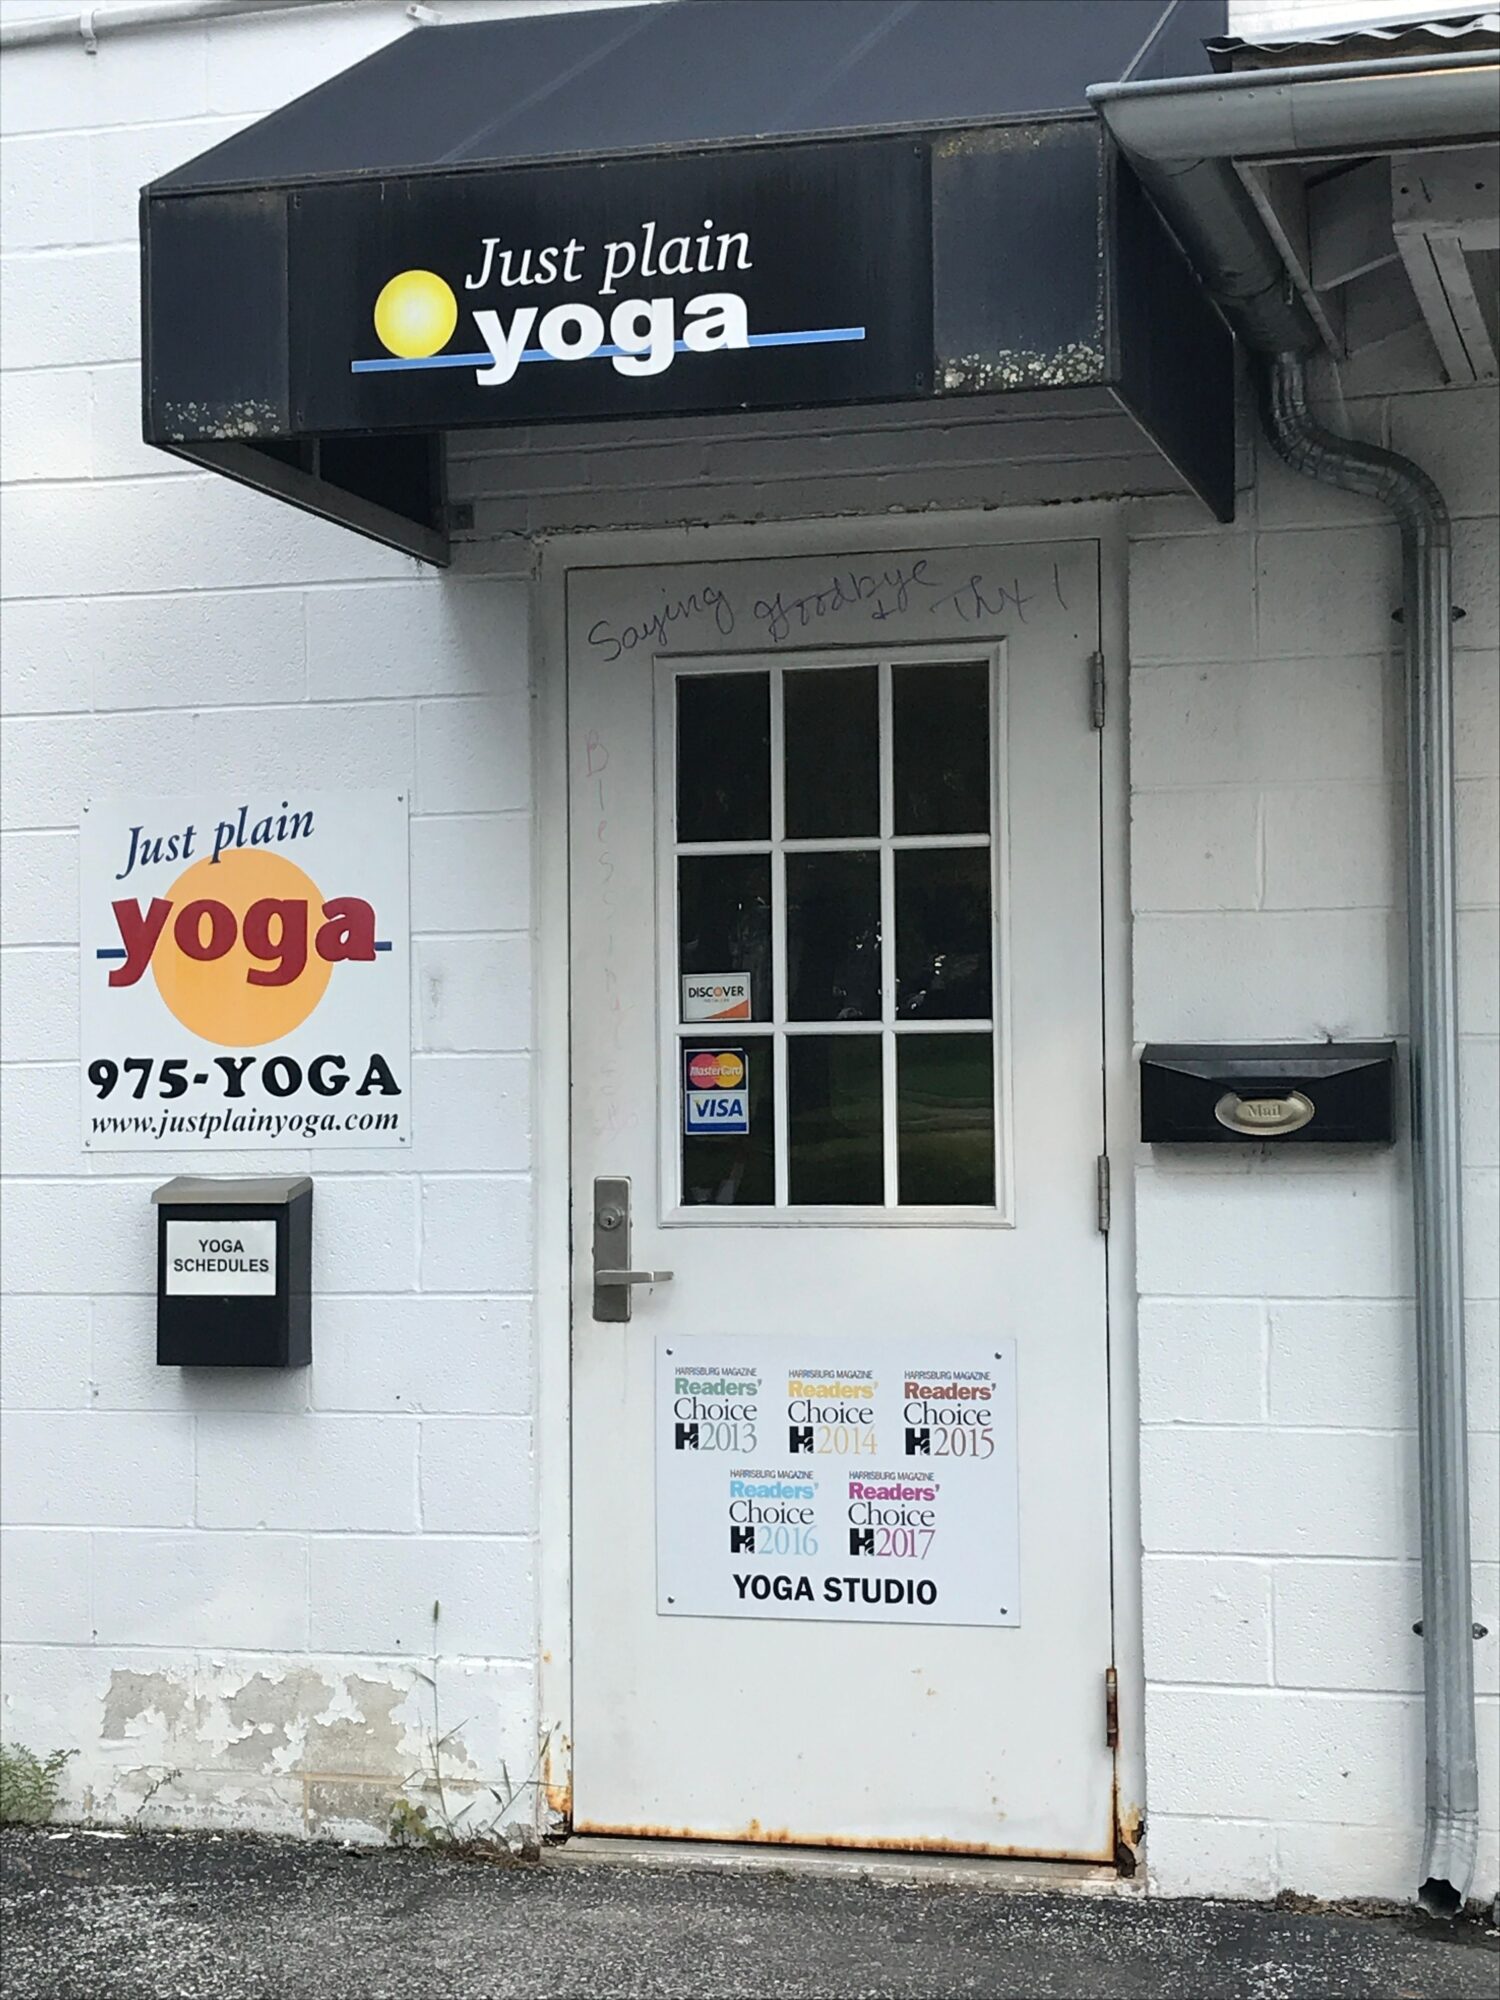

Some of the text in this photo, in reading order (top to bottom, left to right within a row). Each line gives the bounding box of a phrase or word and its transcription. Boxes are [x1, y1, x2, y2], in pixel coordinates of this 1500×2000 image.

[465, 219, 753, 295] Just plain
[472, 293, 751, 386] yoga
[587, 584, 734, 662] Saying
[754, 559, 937, 643] goodbye
[115, 800, 315, 880] Just plain
[108, 896, 377, 988] yoga
[688, 986, 745, 998] DISCOVER
[88, 1054, 402, 1100] 975-YOGA
[689, 1064, 743, 1077] MasterCard
[694, 1099, 743, 1118] VISA
[1246, 1104, 1282, 1118] Mail
[92, 1107, 399, 1139] www.justplainyoga.com
[199, 1239, 245, 1253] YOGA
[173, 1258, 270, 1273] SCHEDULES
[721, 1367, 757, 1377] MAGAZINE
[836, 1370, 873, 1380] MAGAZINE
[953, 1371, 991, 1381] MAGAZINE
[673, 1396, 757, 1421] Choice
[787, 1399, 873, 1424] Choice
[903, 1400, 991, 1426] Choice
[700, 1421, 758, 1454] 2013
[817, 1425, 878, 1455] 2014
[933, 1426, 995, 1460] 2015
[777, 1470, 814, 1480] MAGAZINE
[897, 1472, 935, 1482] MAGAZINE
[729, 1500, 814, 1525] Choice
[848, 1501, 936, 1527] Choice
[758, 1524, 819, 1556] 2016
[876, 1527, 936, 1560] 2017
[732, 1573, 938, 1606] YOGA STUDIO
